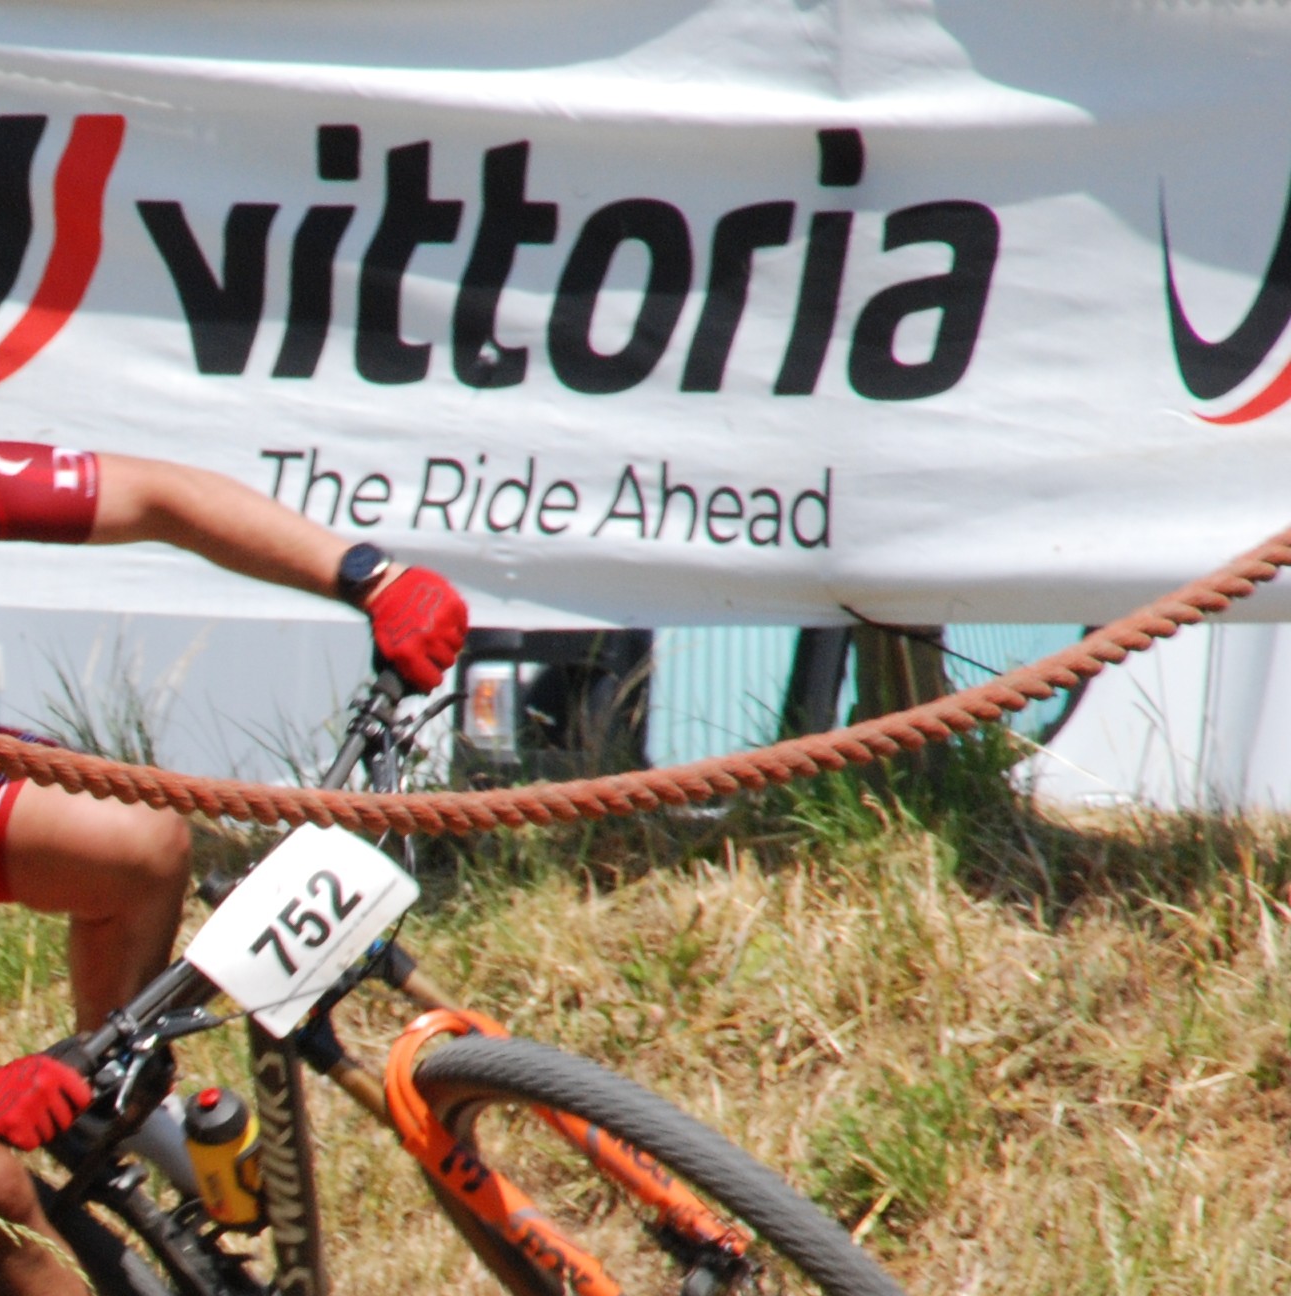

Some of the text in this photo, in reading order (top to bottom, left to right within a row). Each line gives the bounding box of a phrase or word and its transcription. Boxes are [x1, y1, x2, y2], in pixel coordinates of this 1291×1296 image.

[136, 124, 999, 400] vittoria
[261, 448, 831, 548] The Ride Ahead
[248, 868, 363, 977] 752
